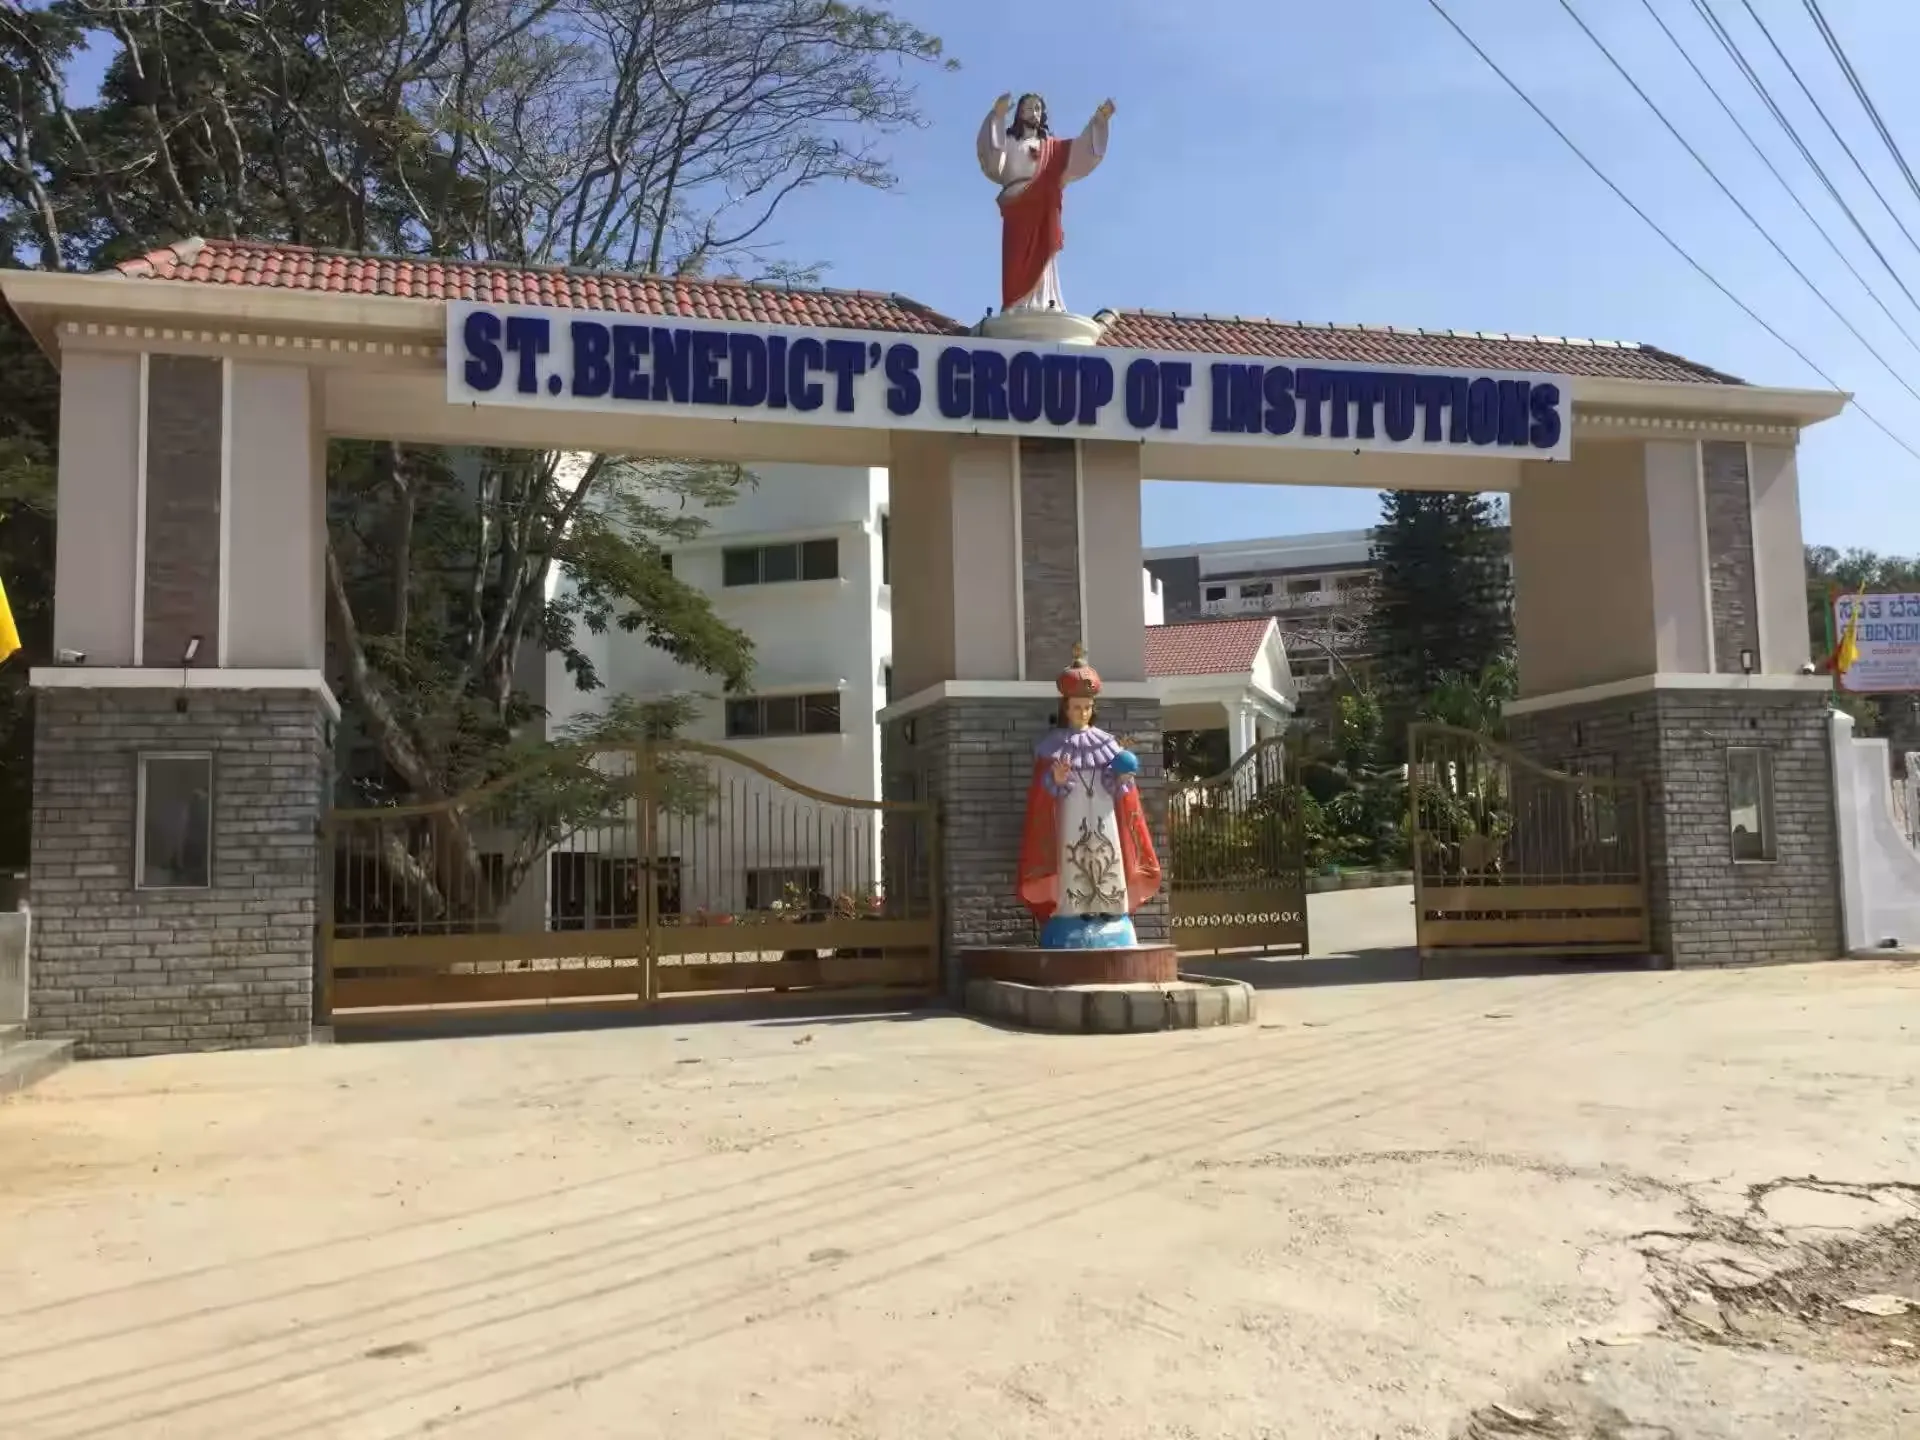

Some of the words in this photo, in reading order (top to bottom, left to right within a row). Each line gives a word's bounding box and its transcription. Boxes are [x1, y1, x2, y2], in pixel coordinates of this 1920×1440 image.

[937, 346, 1114, 426] GROUP
[1125, 358, 1192, 430] OF
[1210, 363, 1561, 449] INSTITUTIONS
